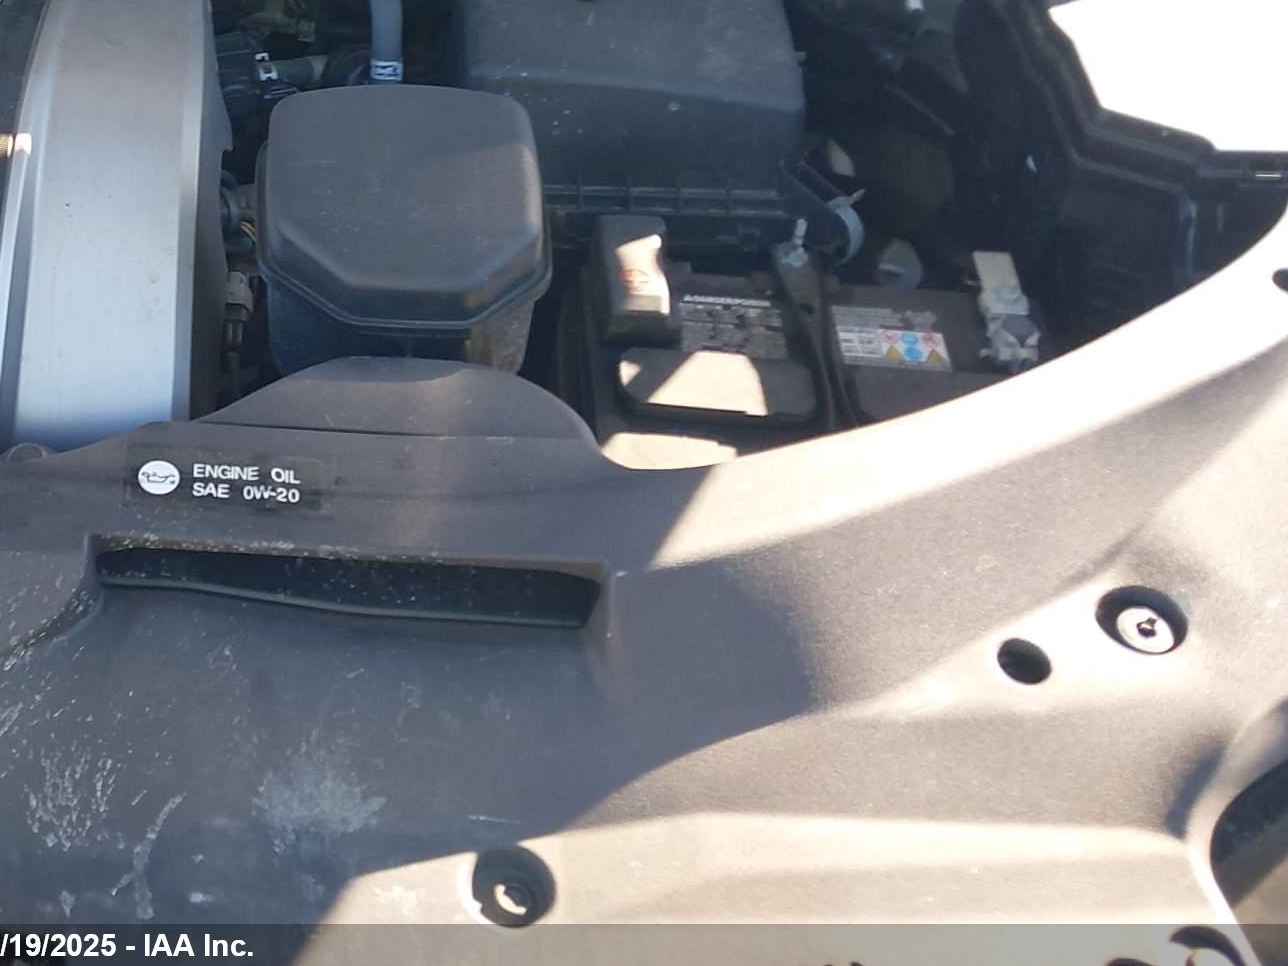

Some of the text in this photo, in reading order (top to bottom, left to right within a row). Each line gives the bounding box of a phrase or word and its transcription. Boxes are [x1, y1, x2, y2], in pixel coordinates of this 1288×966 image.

[192, 463, 302, 484] ENGINE OIL
[192, 482, 300, 503] SAE 0W-20
